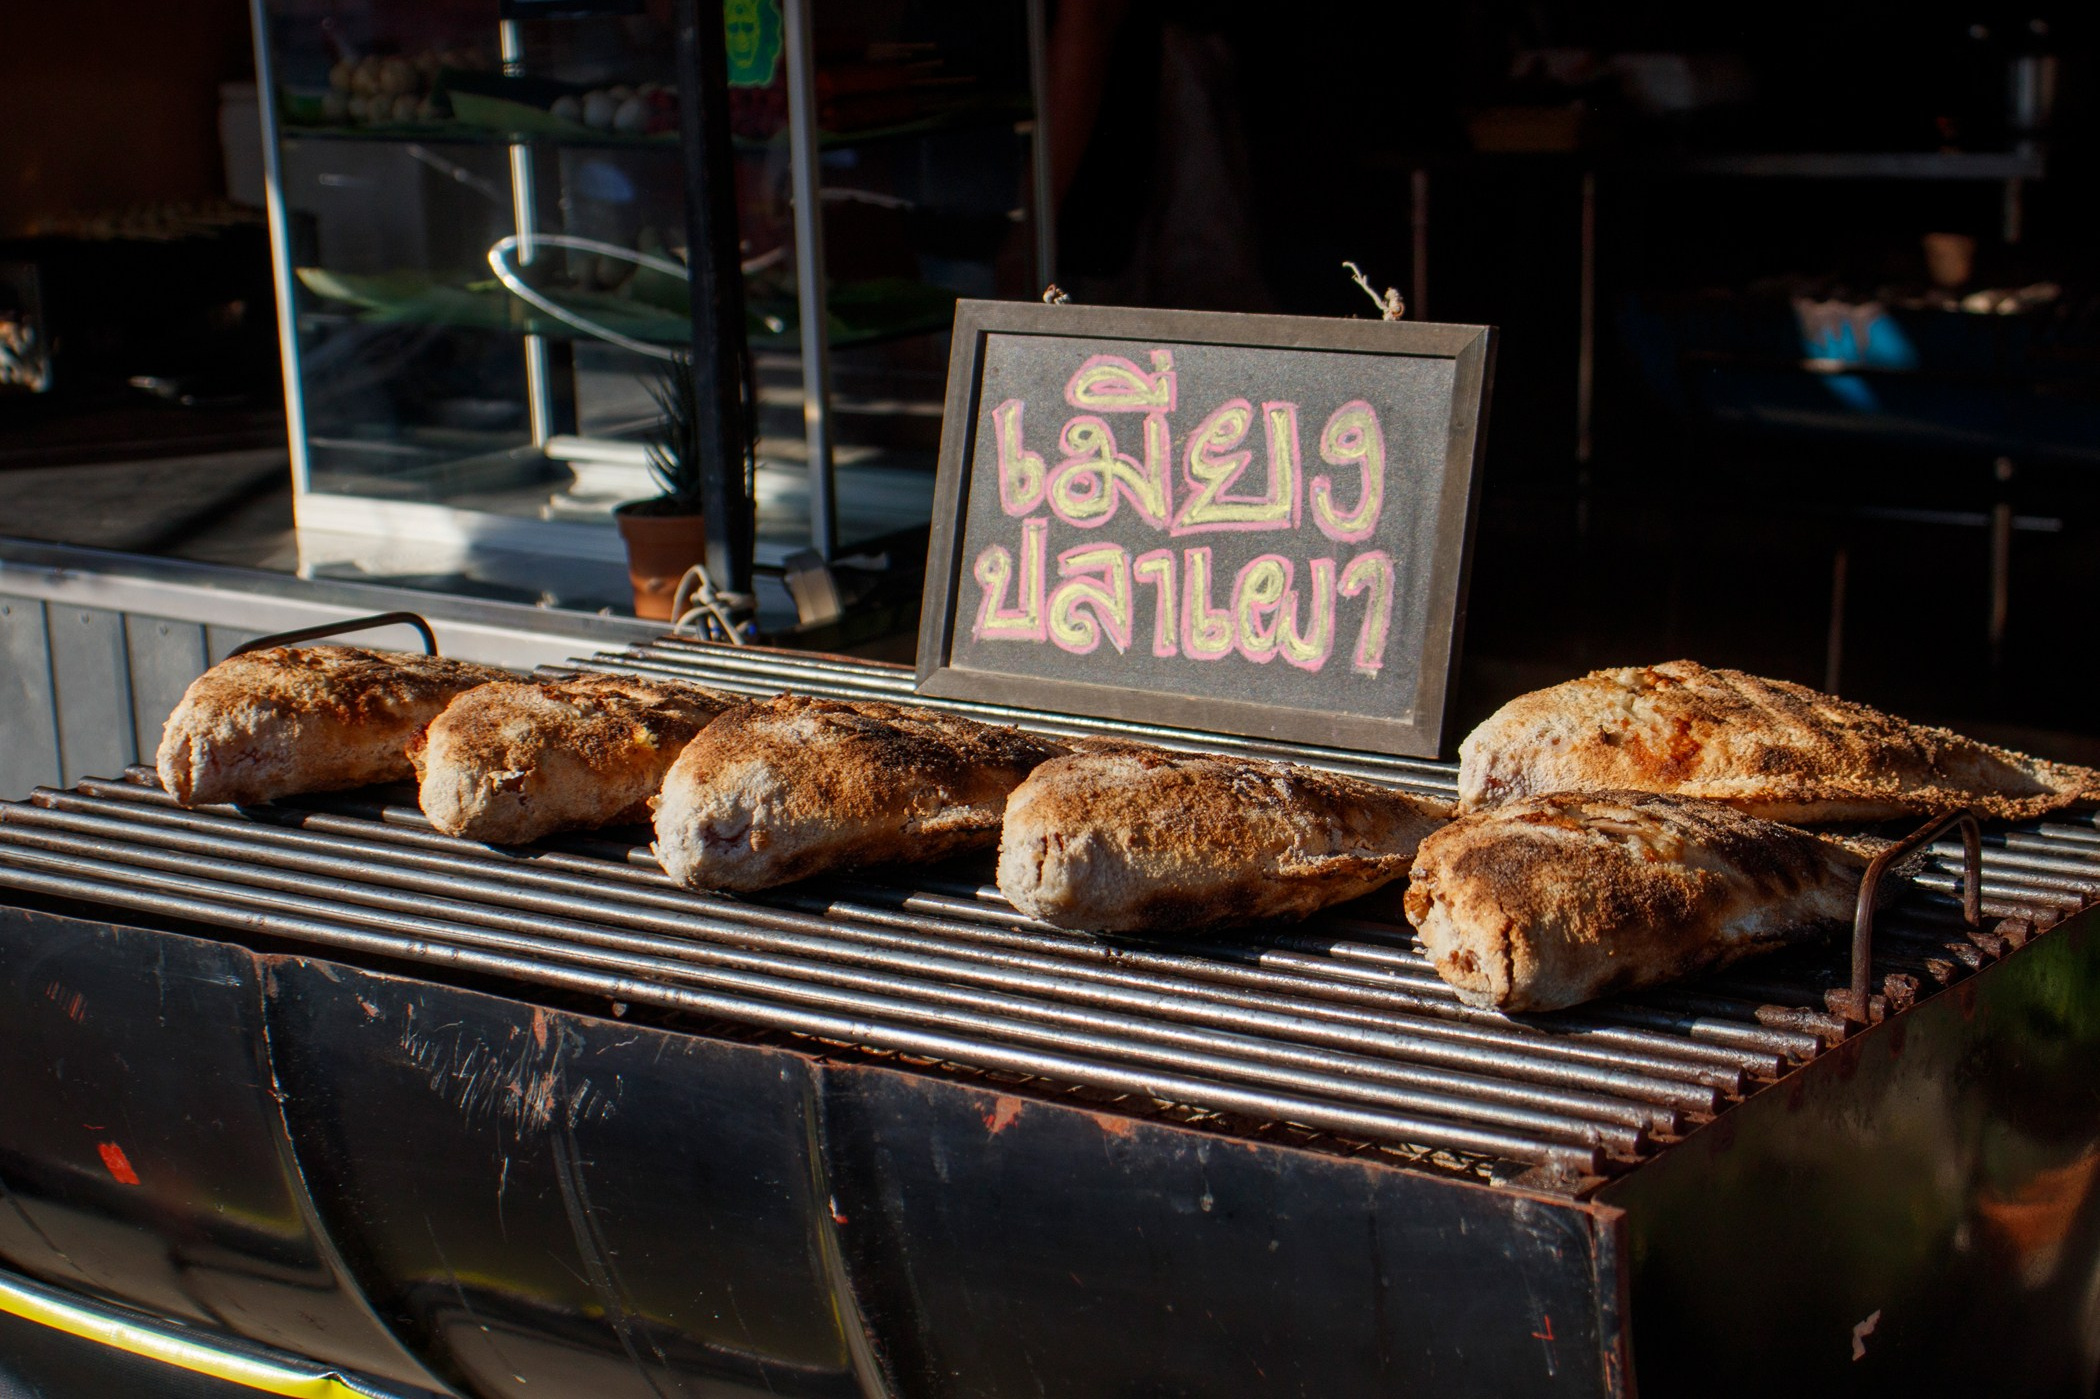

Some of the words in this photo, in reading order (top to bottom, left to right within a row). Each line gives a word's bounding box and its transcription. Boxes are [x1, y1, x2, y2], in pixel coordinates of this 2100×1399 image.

[992, 349, 1386, 543] เมี่ยง
[973, 518, 1395, 674] ปลาเผา
